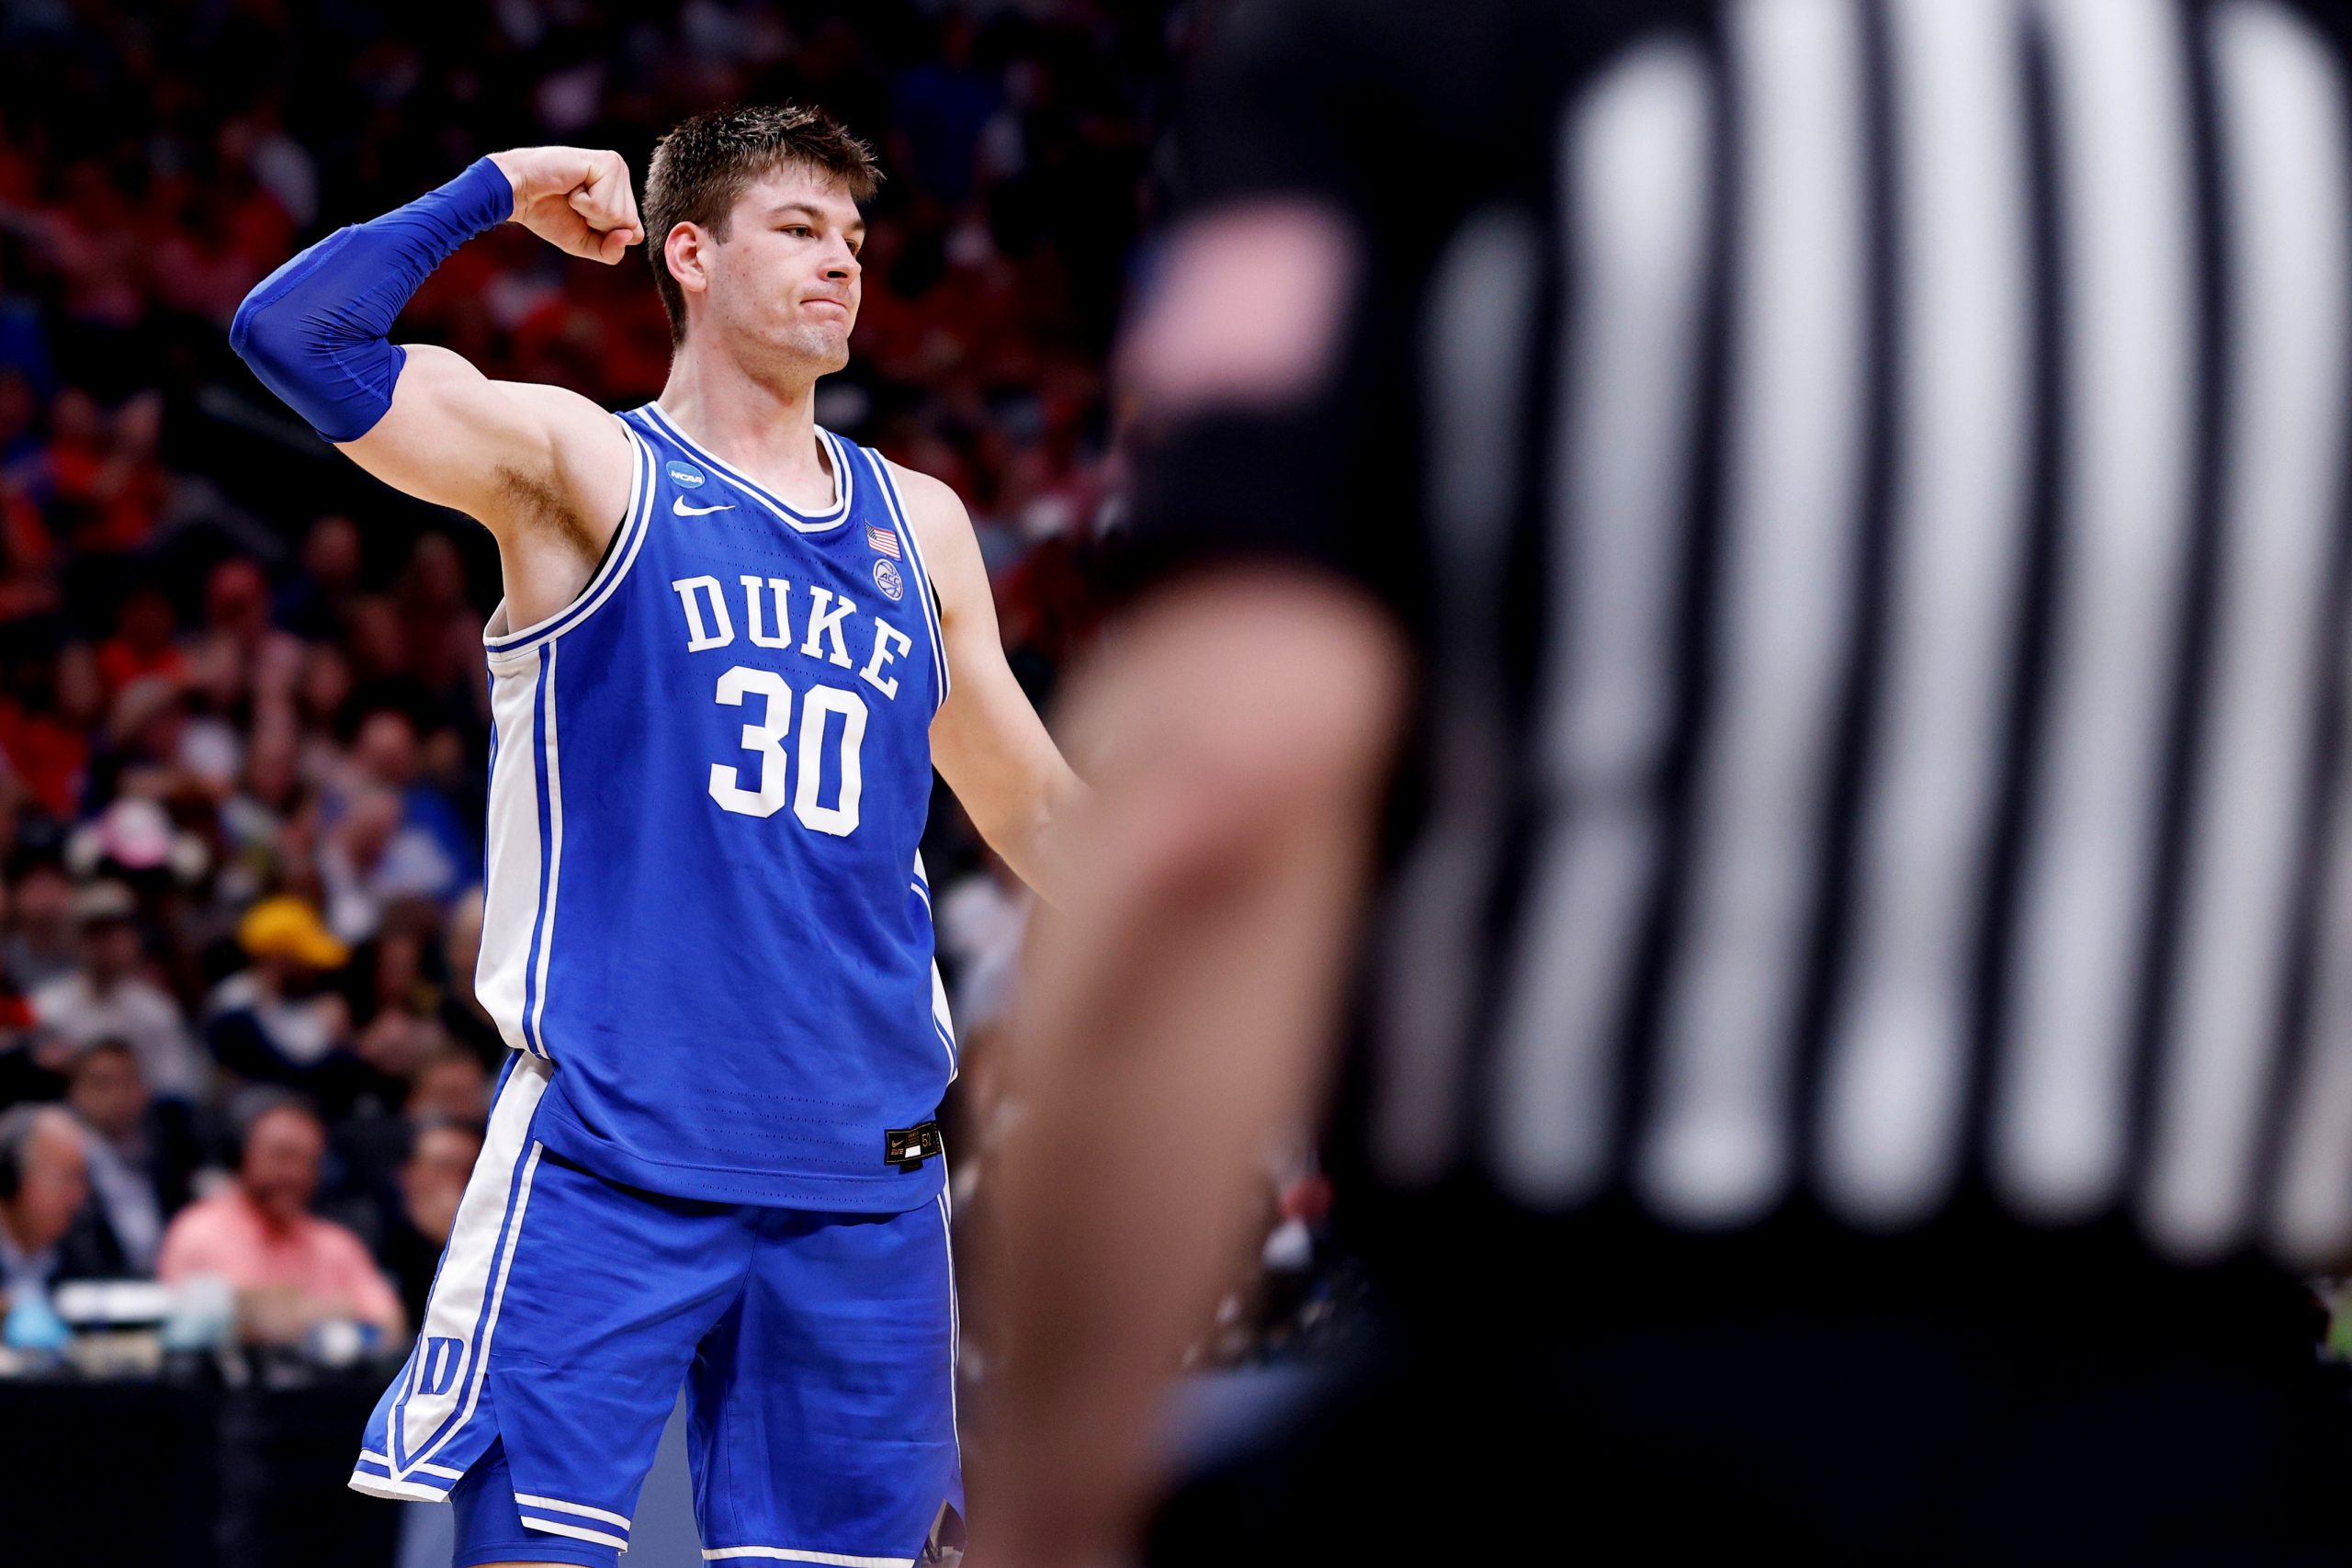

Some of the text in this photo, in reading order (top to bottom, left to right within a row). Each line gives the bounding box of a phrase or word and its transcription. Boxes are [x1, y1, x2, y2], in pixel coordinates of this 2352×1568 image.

[672, 469, 702, 484] NCAA
[880, 572, 899, 583] ACC
[672, 575, 912, 701] DUKE
[708, 665, 868, 838] 30
[418, 1337, 464, 1395] D
